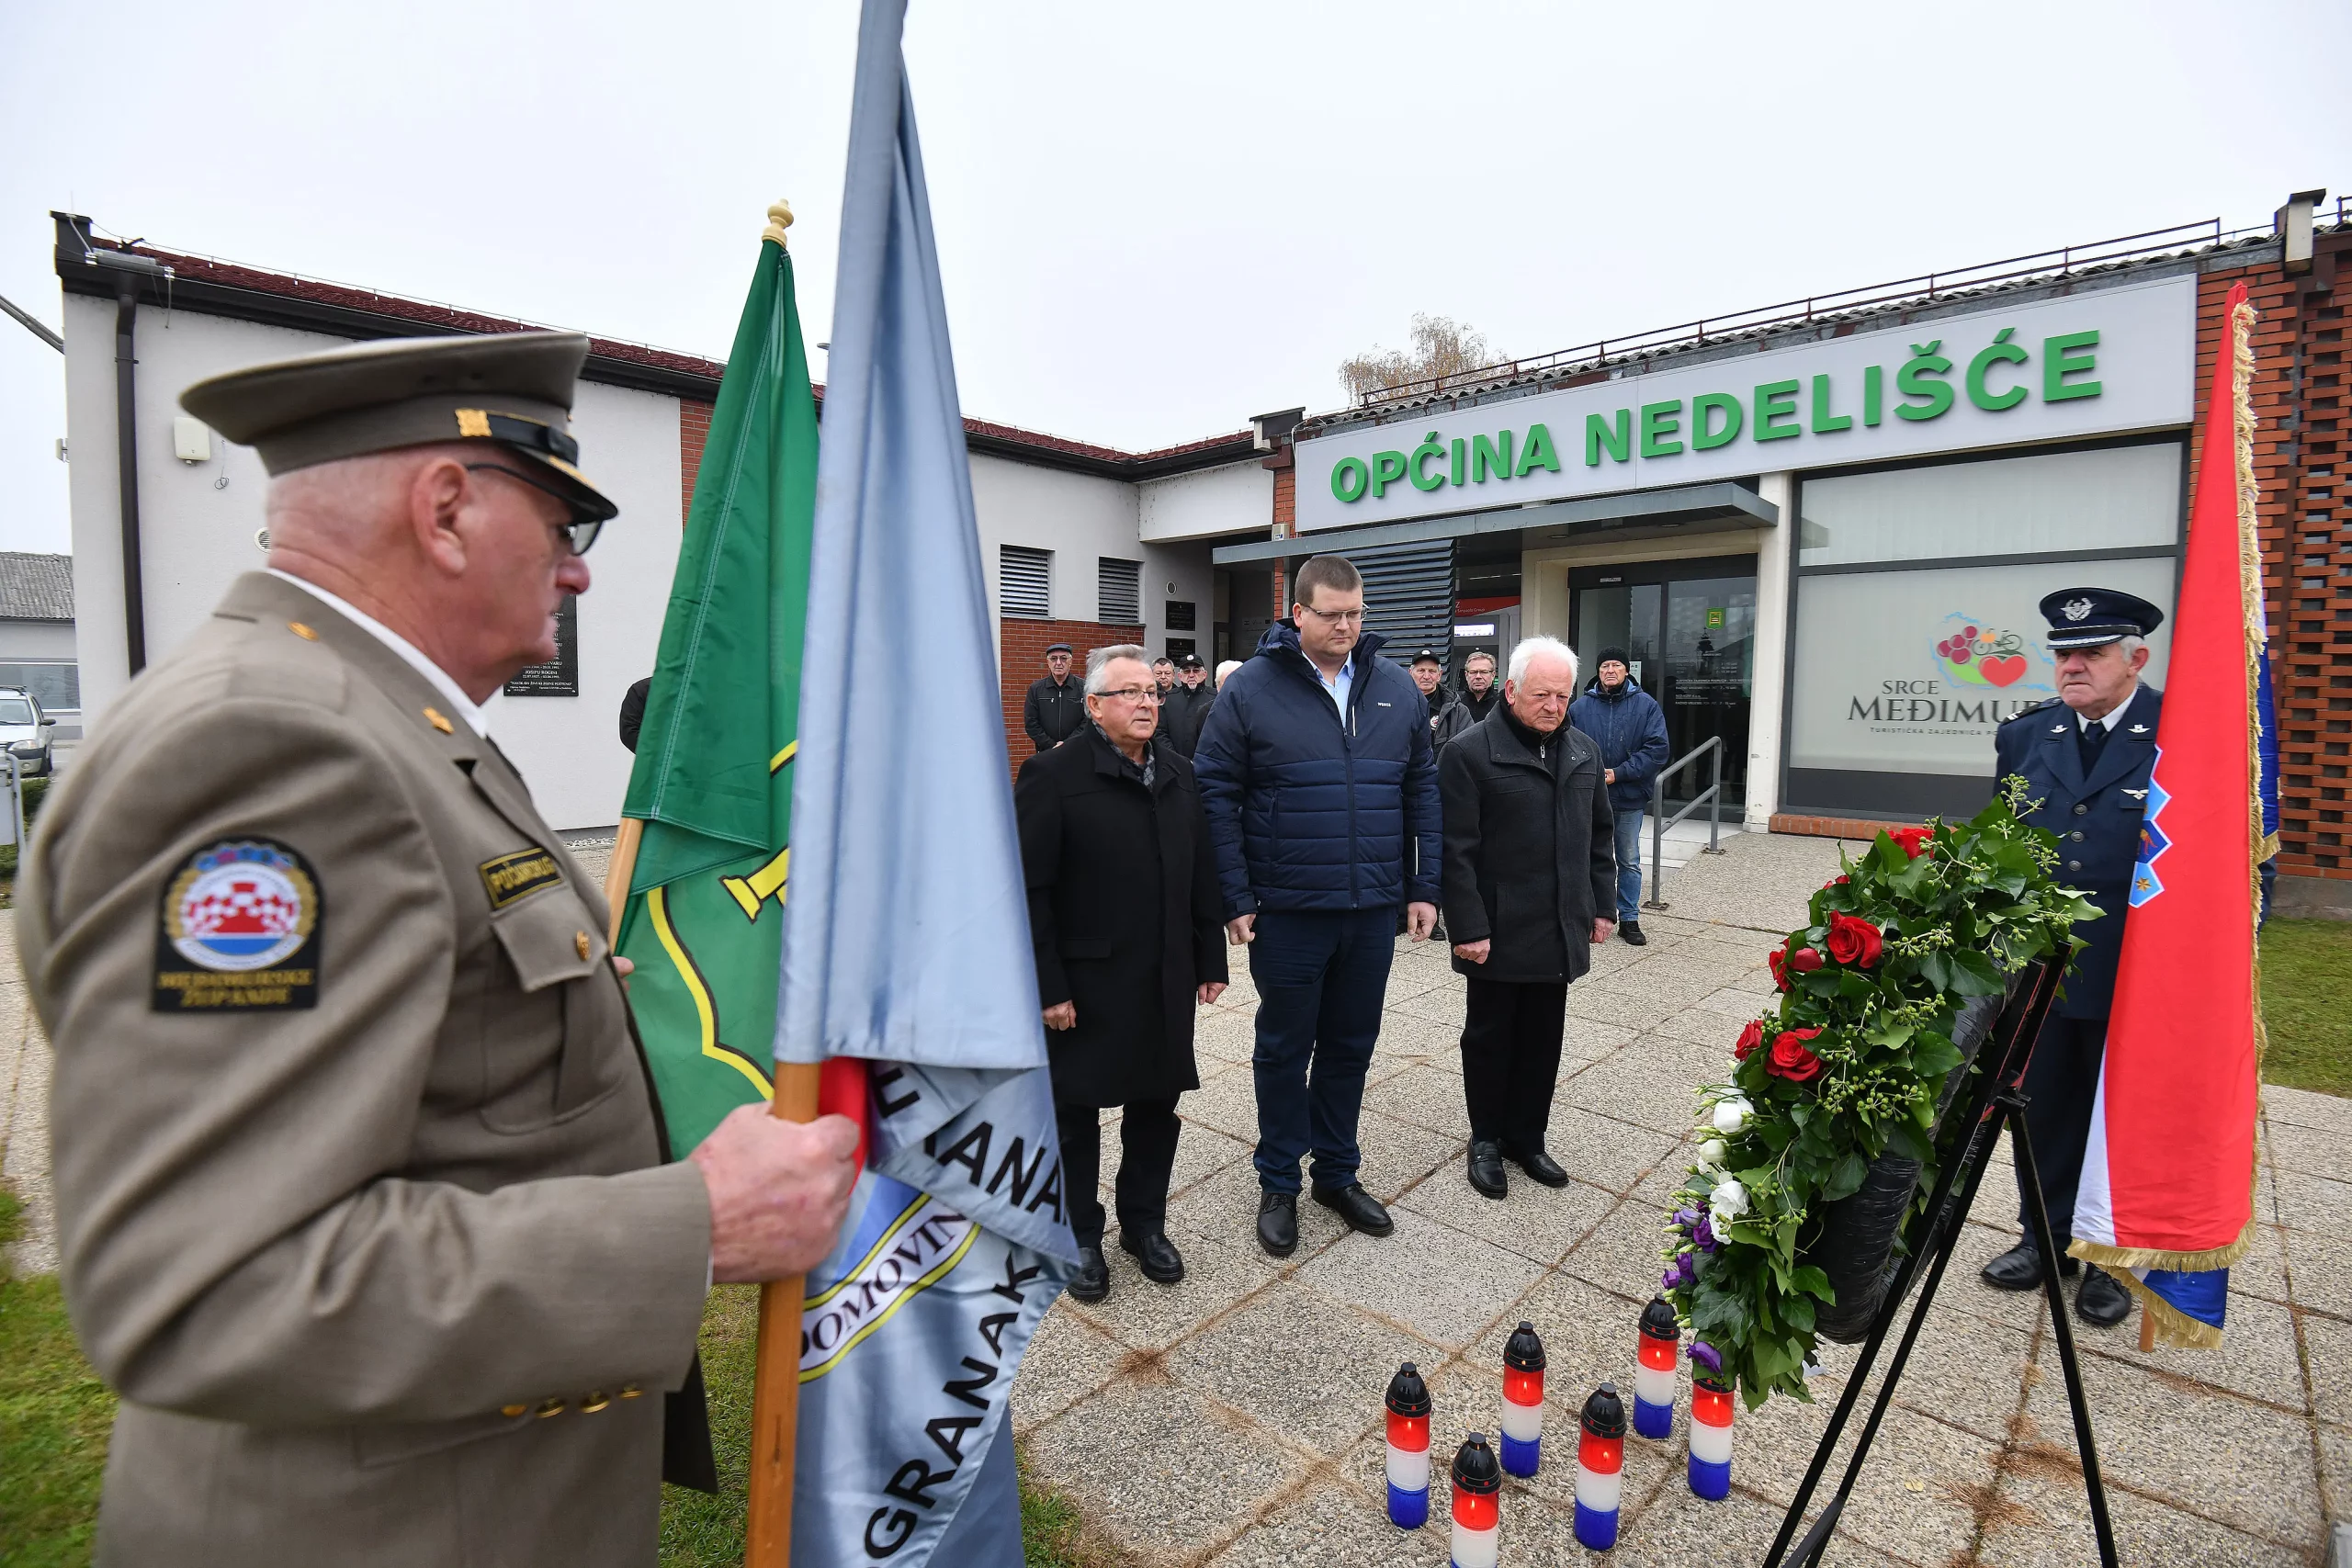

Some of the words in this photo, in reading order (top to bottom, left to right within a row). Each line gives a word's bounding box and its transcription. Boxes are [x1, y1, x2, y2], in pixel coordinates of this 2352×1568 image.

[1330, 423, 1562, 504] OPĆINA
[1584, 327, 2104, 468] NEDELIŠĆE
[1882, 680, 1939, 695] SRCE
[800, 1213, 967, 1359] OMOVIN
[865, 1248, 1041, 1568] GRANAK
